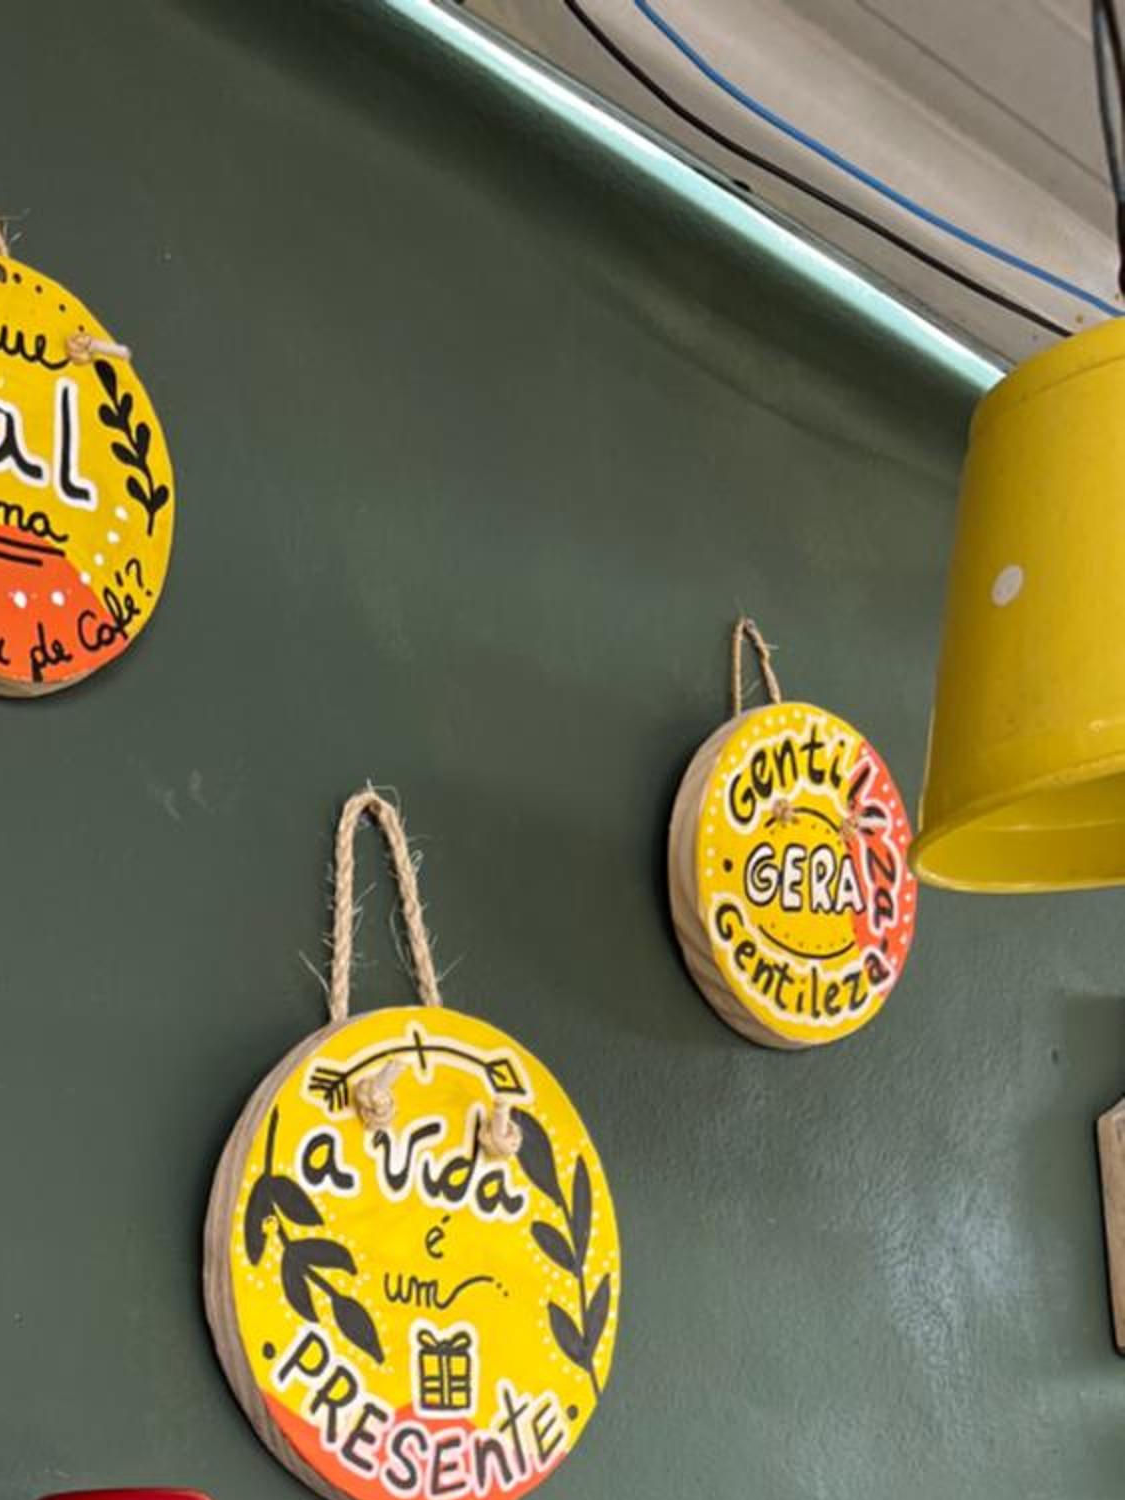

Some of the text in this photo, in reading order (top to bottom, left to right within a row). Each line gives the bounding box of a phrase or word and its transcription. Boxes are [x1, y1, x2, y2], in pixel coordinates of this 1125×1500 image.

[30, 621, 73, 683] de
[744, 841, 866, 916] GERA
[300, 1131, 356, 1191] a
[425, 1214, 452, 1260] é
[383, 1271, 494, 1311] um
